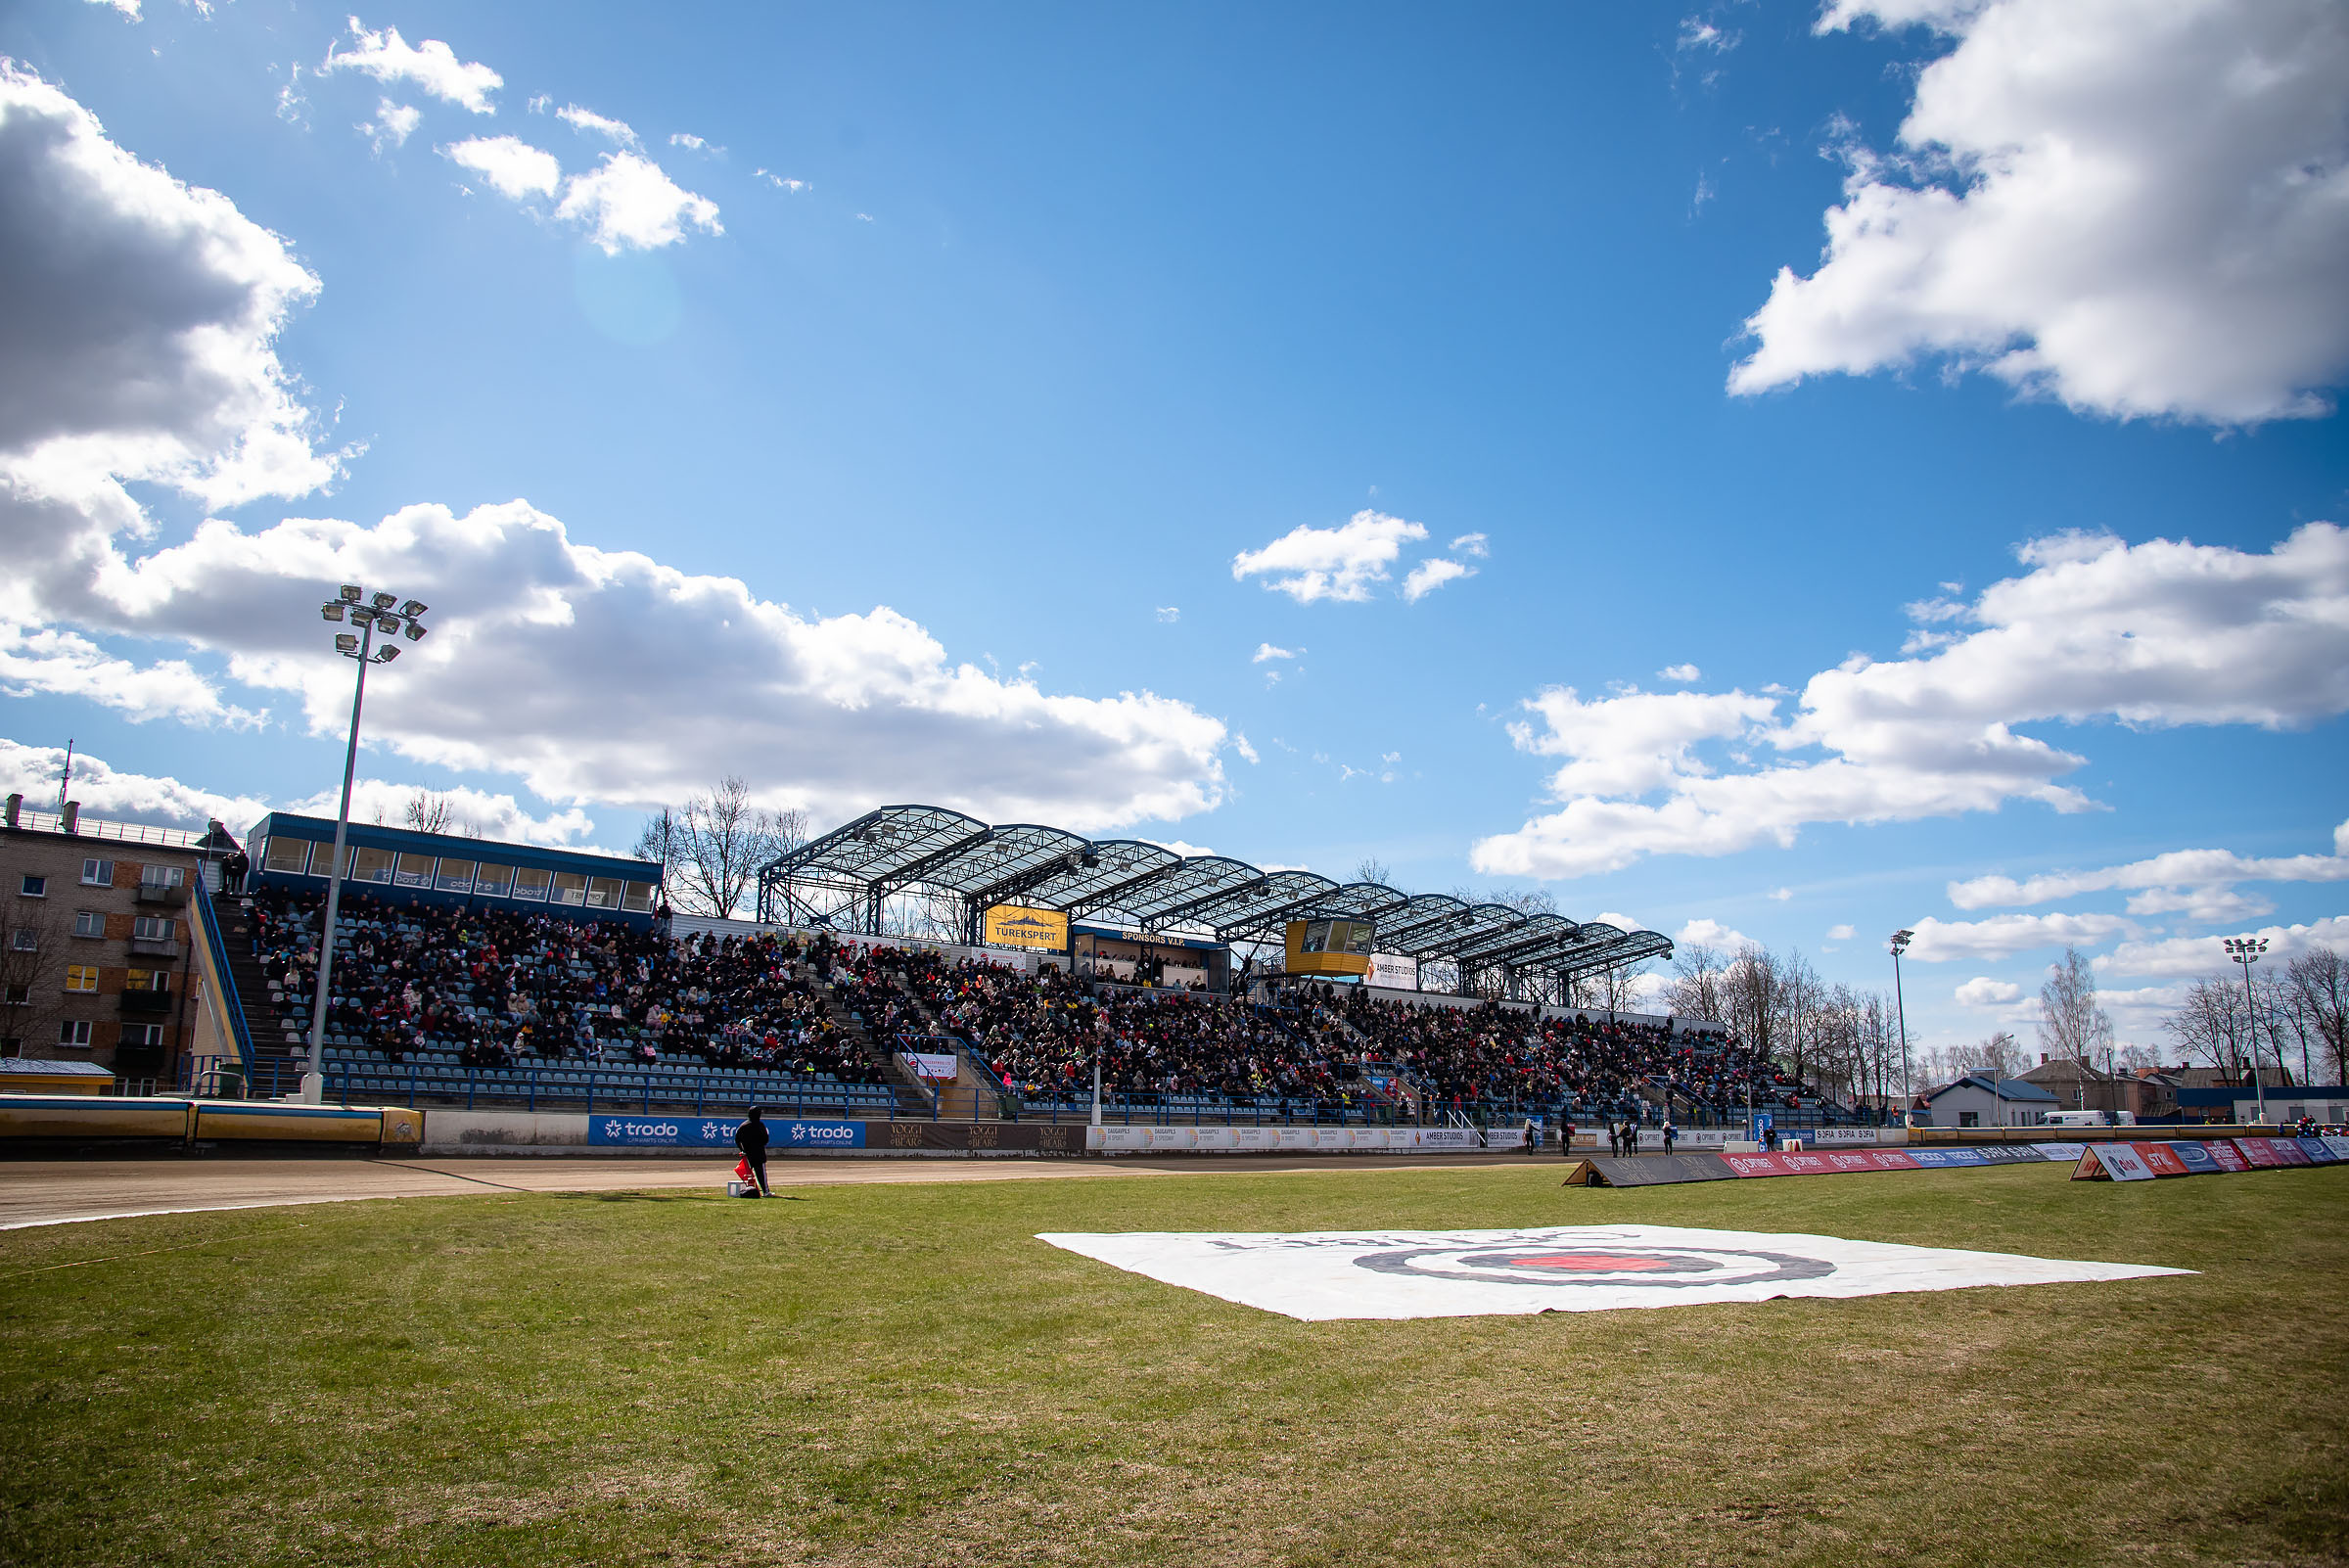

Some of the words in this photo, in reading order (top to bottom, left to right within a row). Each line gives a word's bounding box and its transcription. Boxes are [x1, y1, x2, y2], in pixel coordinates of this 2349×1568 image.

[995, 926, 1057, 942] TUREKSPERT
[1122, 931, 1166, 945] SPONSORS
[1168, 937, 1185, 947] V.I.P.
[1376, 963, 1395, 974] AMBER
[1395, 965, 1416, 977] STUDIOS
[624, 1122, 678, 1136] trodo
[807, 1126, 853, 1139] trodo
[891, 1124, 922, 1134] YOGGI
[968, 1126, 997, 1135] YOGGI
[1039, 1127, 1067, 1136] YOGGI
[1426, 1131, 1444, 1140] AMBER
[1444, 1131, 1464, 1140] STUDIOS
[1488, 1130, 1500, 1140] MBER
[1499, 1131, 1518, 1140] STUDIOS
[1742, 1158, 1774, 1169] OPTIBET
[1793, 1156, 1823, 1167] OPTIBET
